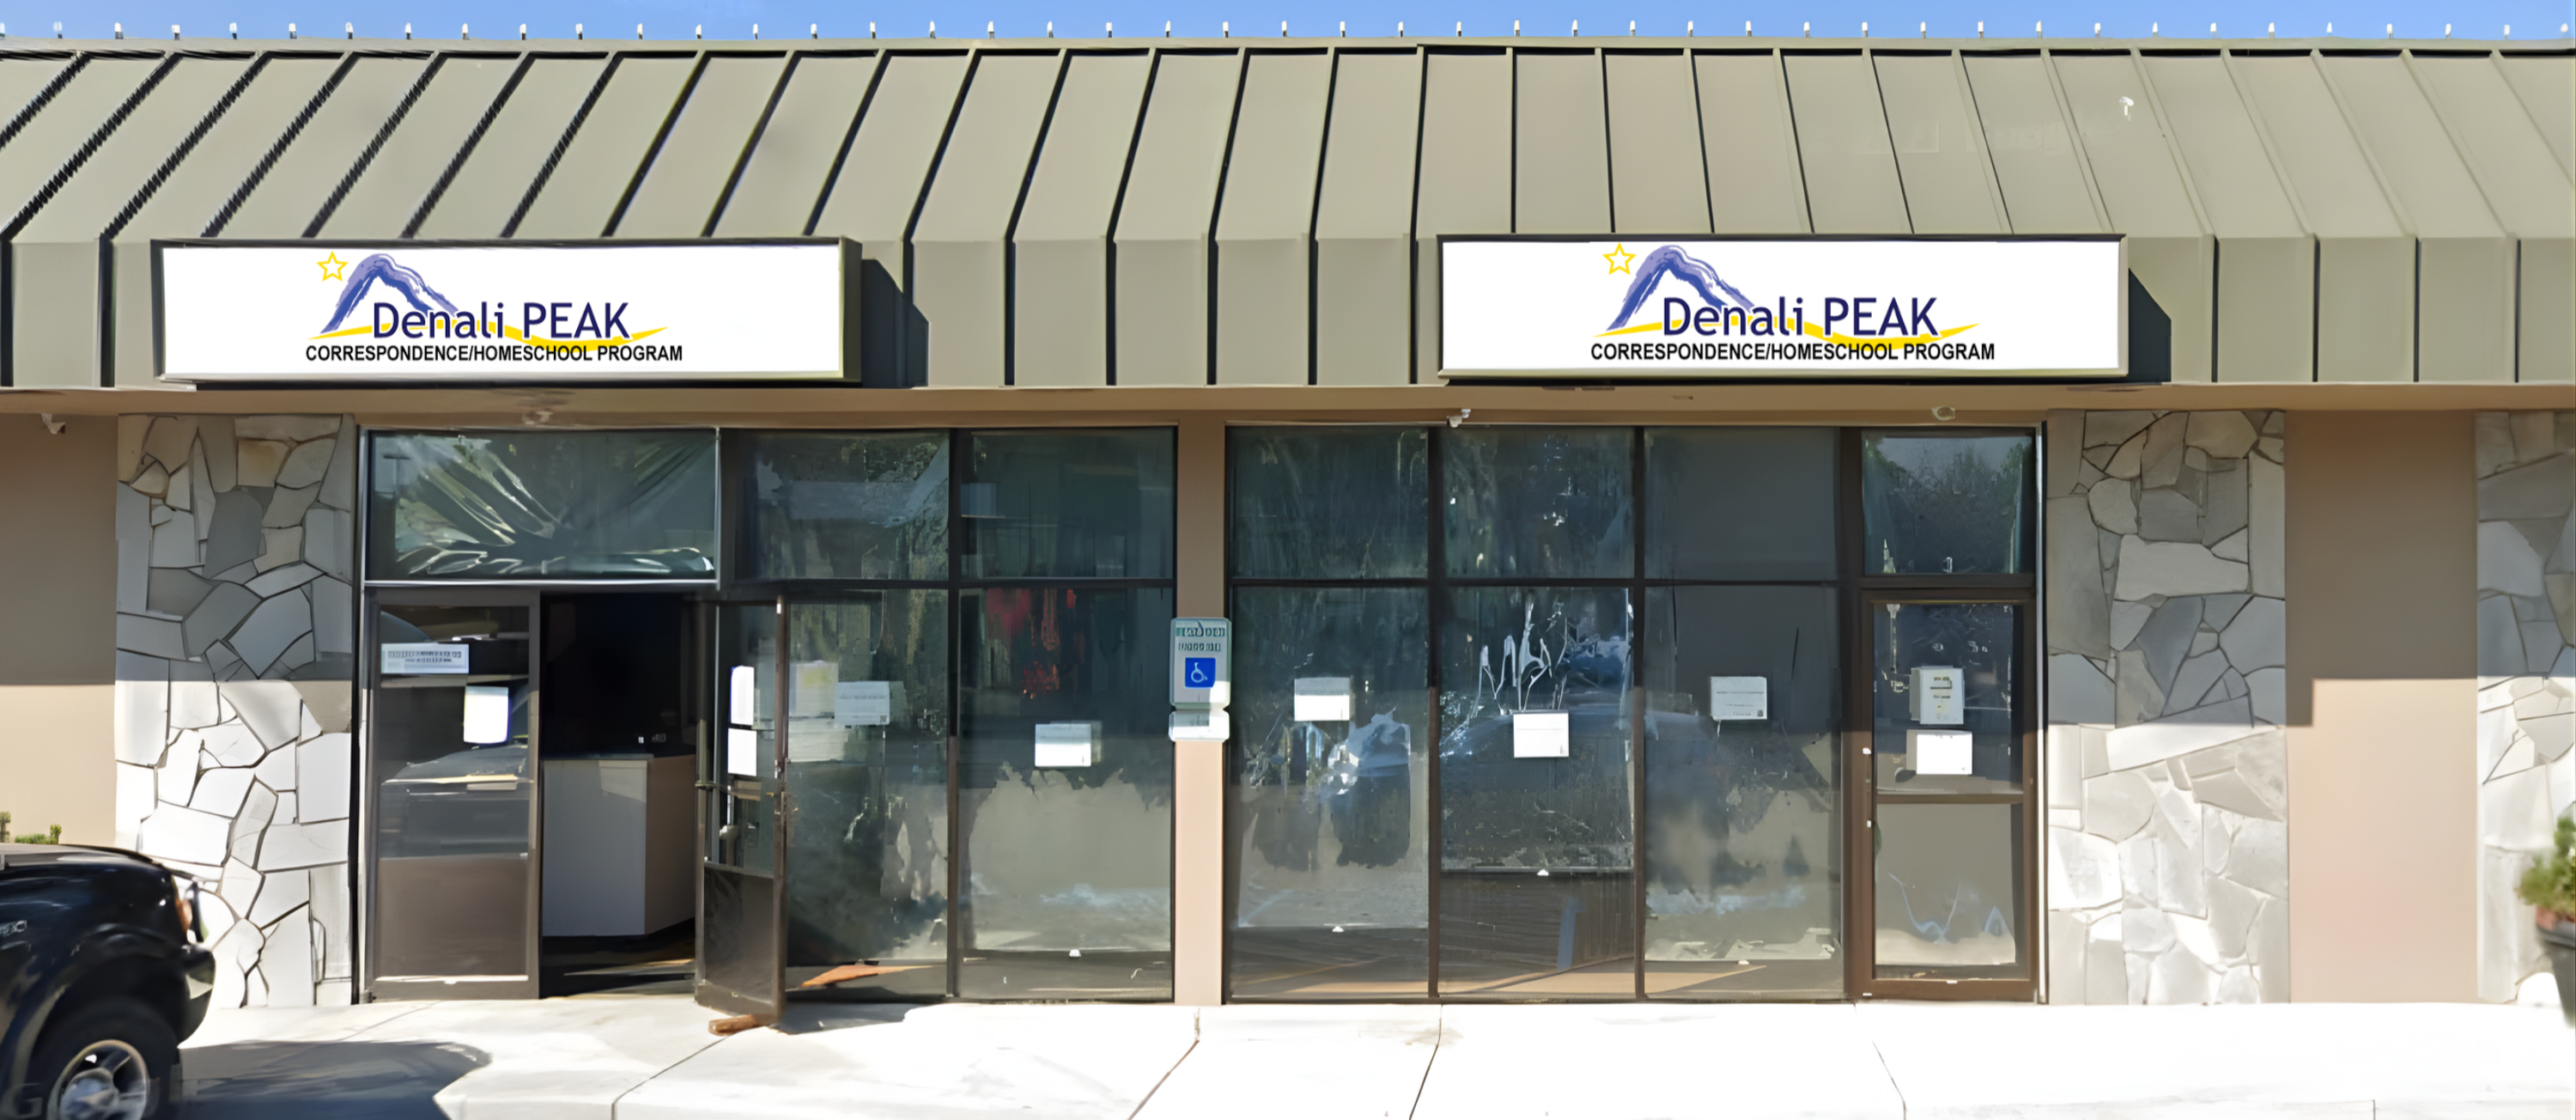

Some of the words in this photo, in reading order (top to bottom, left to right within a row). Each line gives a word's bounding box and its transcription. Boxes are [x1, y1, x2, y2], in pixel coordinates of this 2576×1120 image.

[374, 301, 503, 339] Denali
[524, 302, 629, 338] PEAK
[1664, 296, 1802, 336] Denali
[1826, 296, 1938, 336] PEAK
[306, 345, 592, 362] CORRESPONDENCE/HOMESCHOOL
[598, 345, 683, 362] PROGRAM
[1590, 343, 1899, 360] CORRESPONDENCE/HOMESCHOOL
[1904, 343, 1995, 360] PROGRAM
